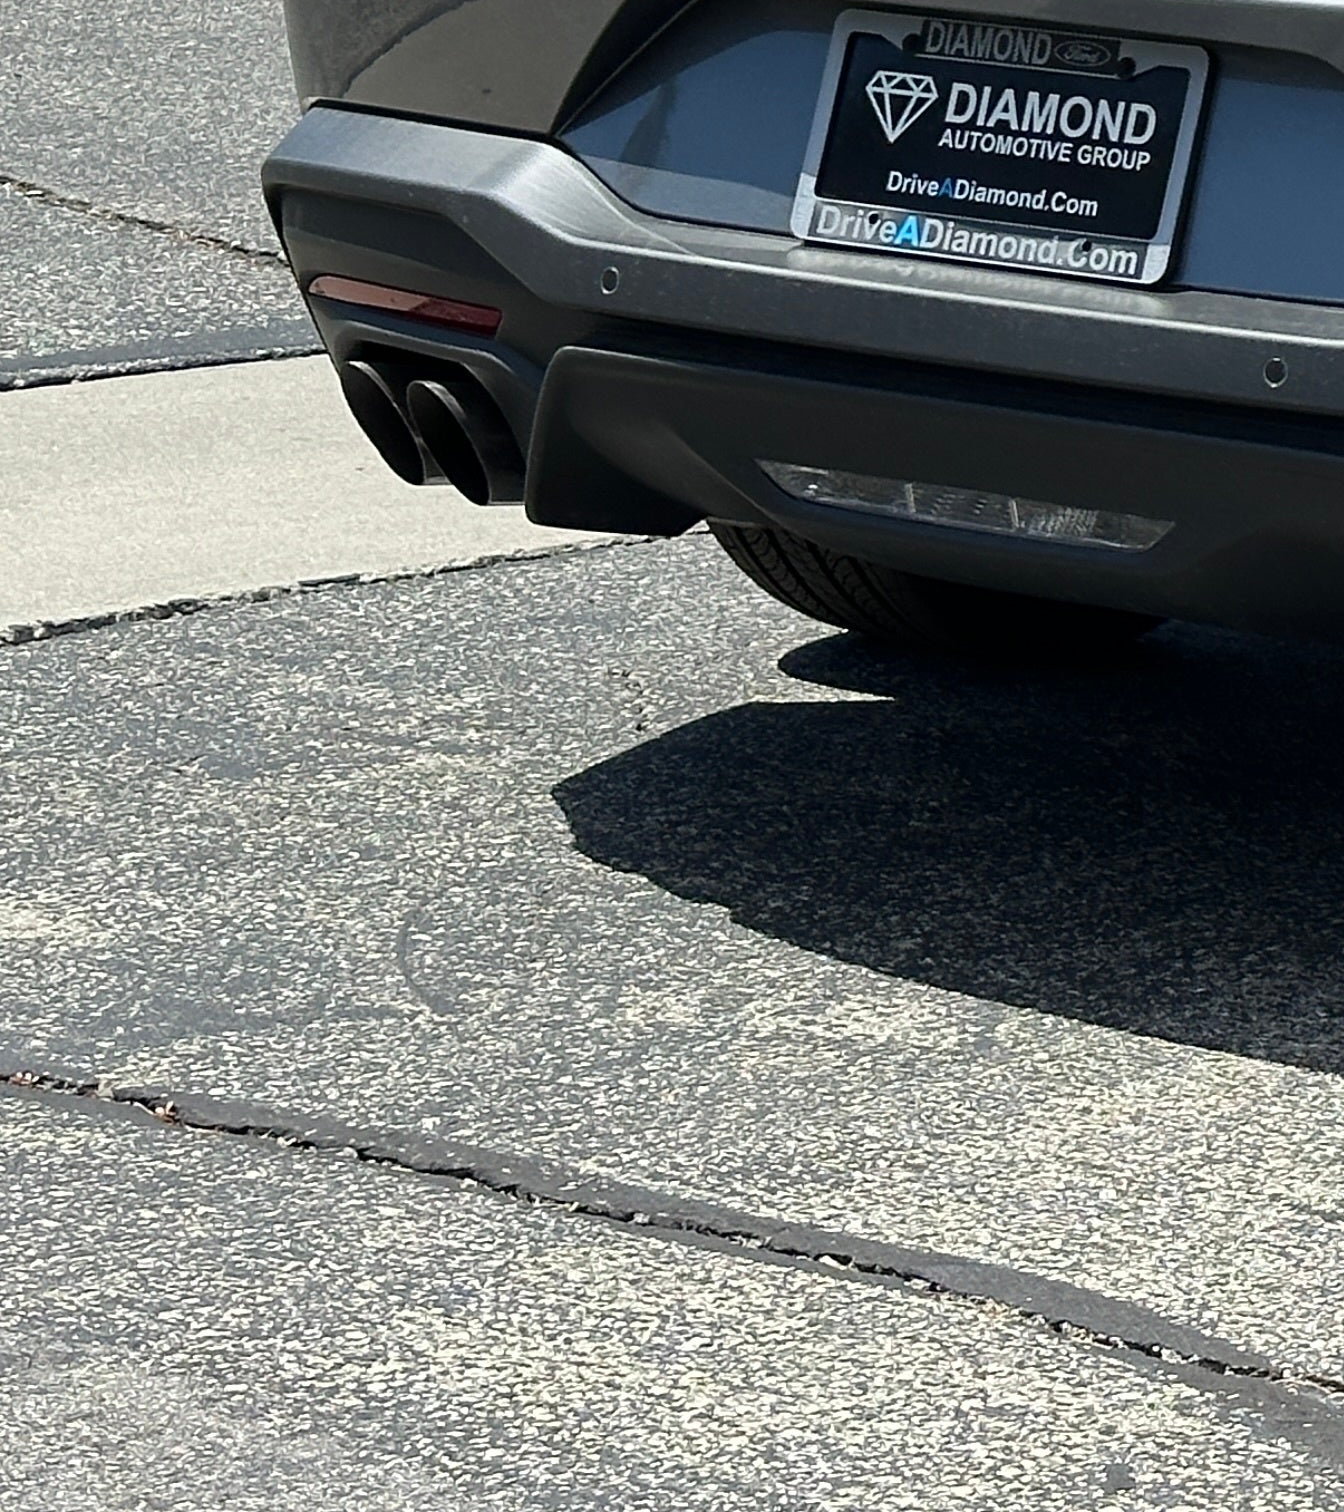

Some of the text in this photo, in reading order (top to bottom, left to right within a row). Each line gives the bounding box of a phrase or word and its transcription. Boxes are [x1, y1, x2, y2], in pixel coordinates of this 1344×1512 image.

[926, 21, 1053, 66] DIAMOND
[944, 82, 1157, 145] DIAMOND
[938, 128, 1152, 172] AUTOMOTIVE GROUP
[885, 170, 1099, 218] DriveADiamond.Com
[815, 204, 1139, 277] DriveADiamond.Com
